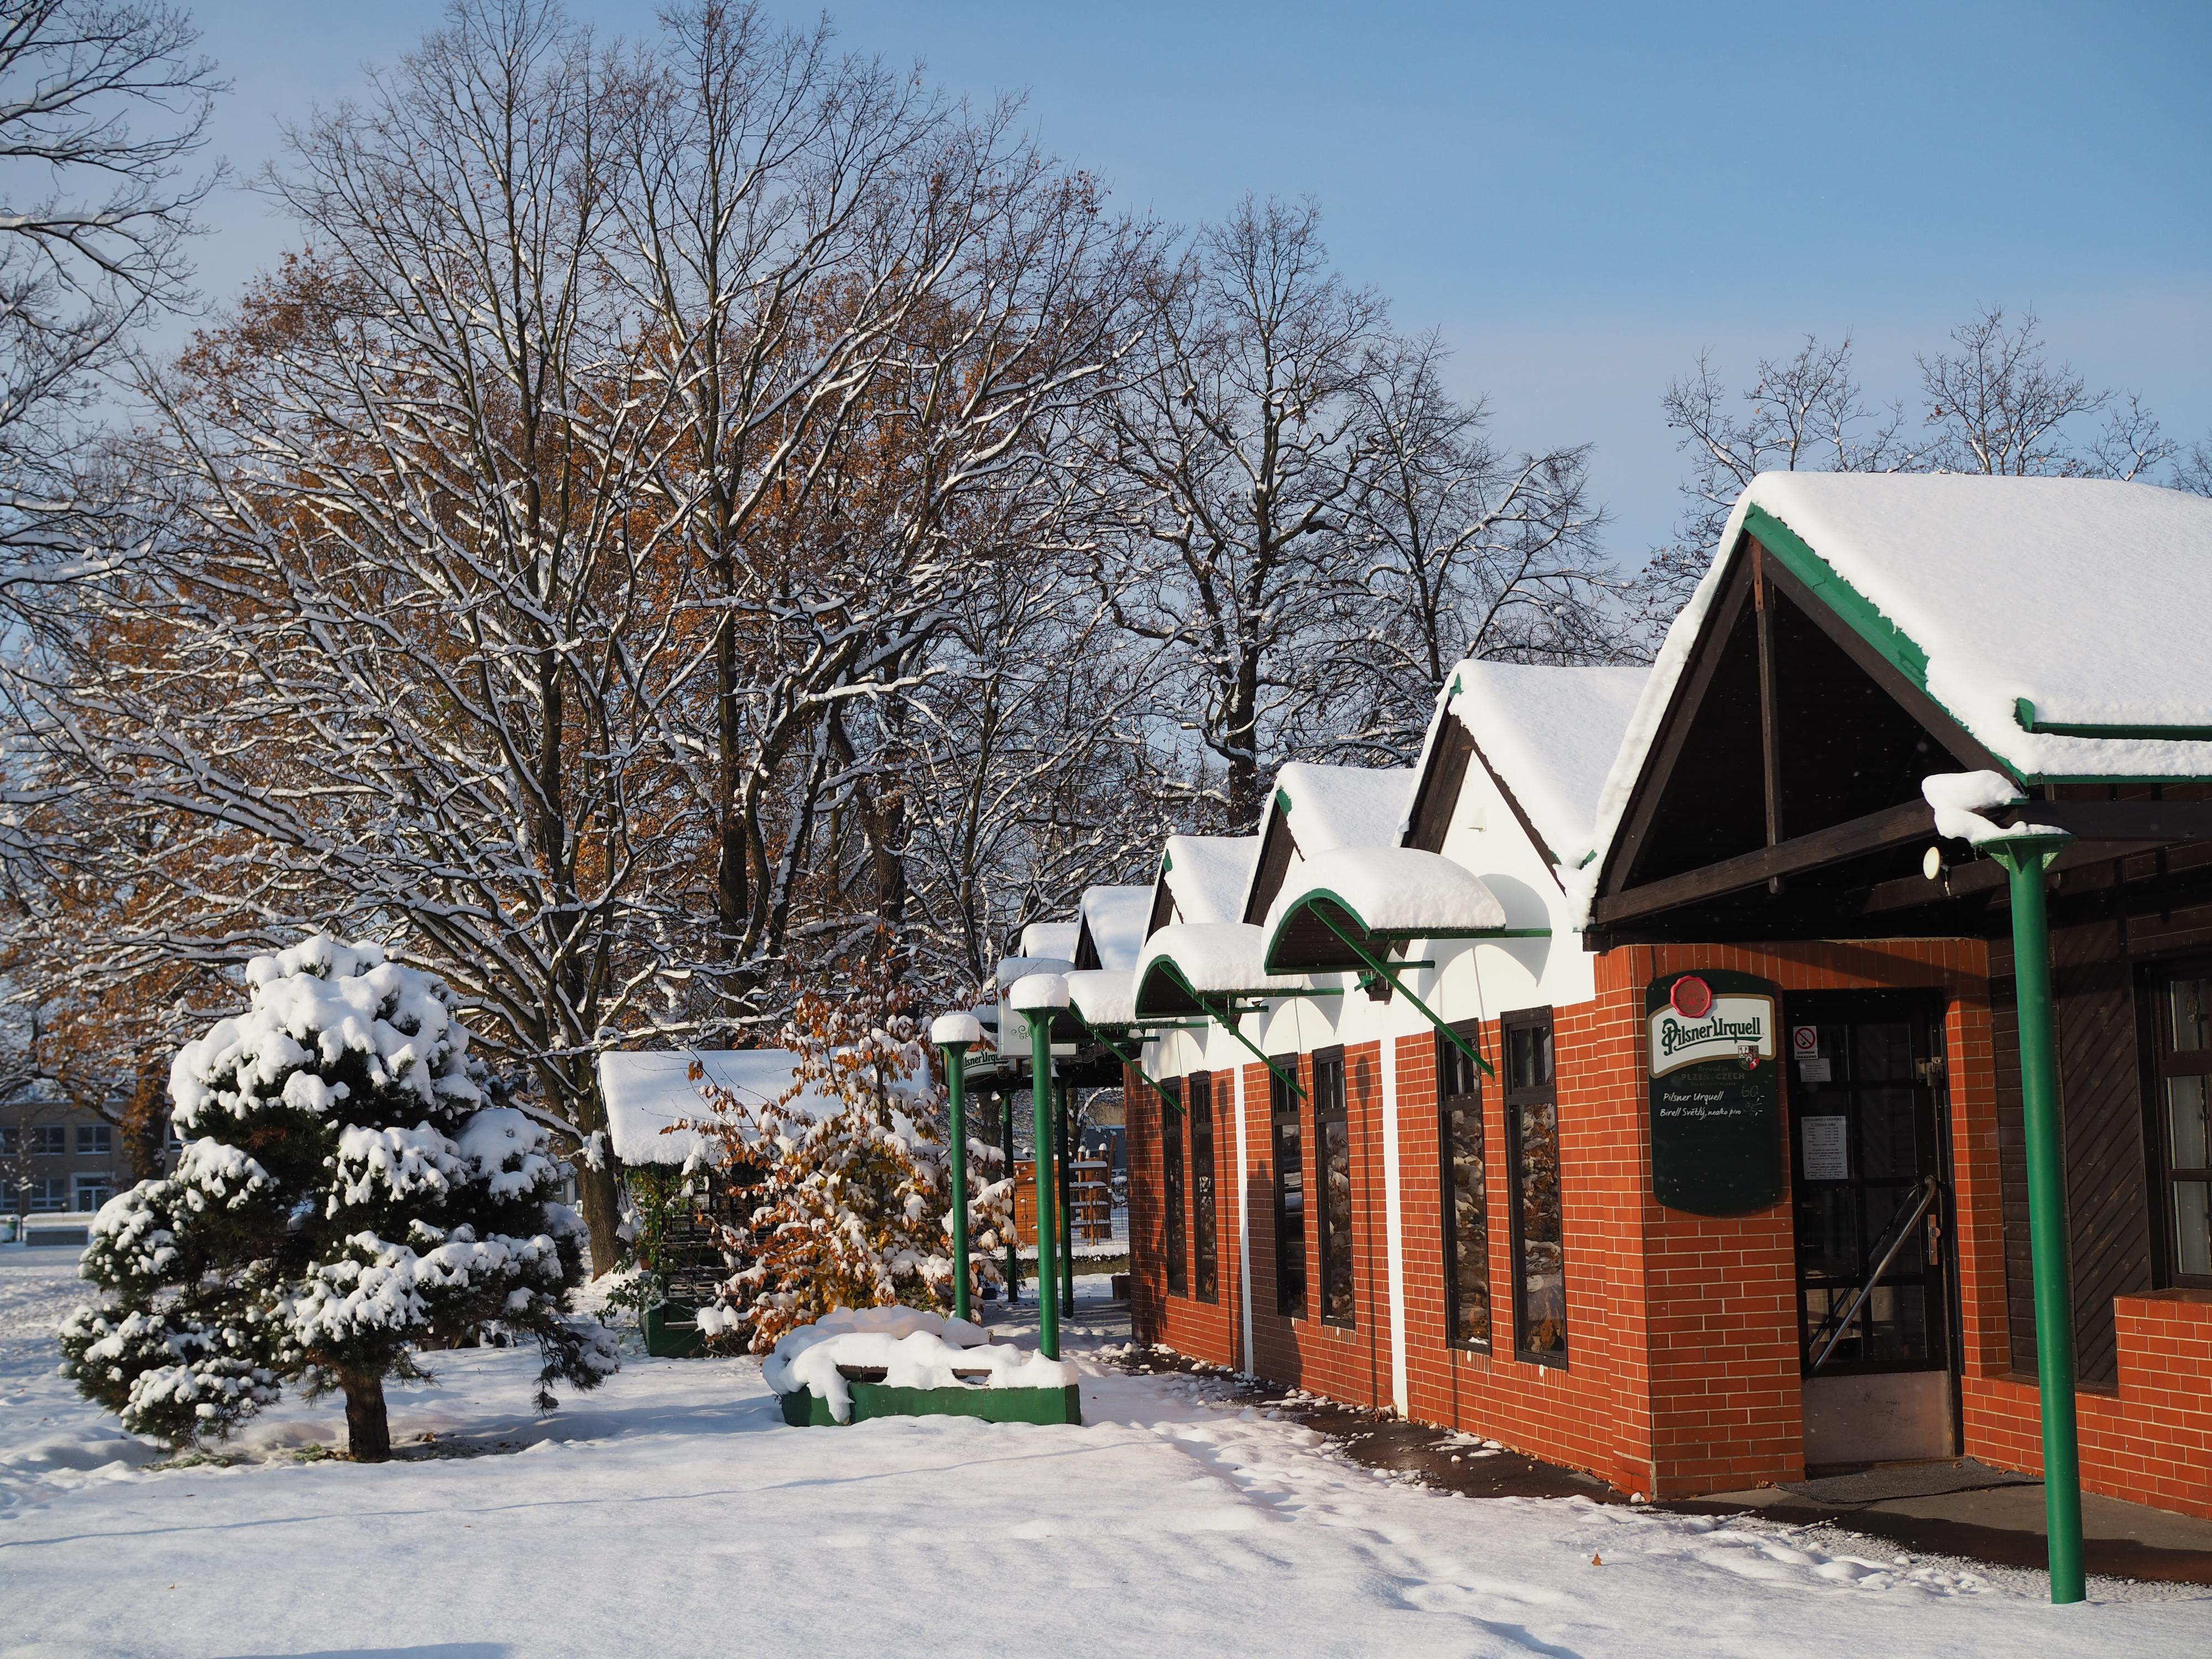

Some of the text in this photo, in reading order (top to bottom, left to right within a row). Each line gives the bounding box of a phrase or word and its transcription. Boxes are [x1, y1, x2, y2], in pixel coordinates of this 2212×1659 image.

[1661, 1016, 1761, 1056] Pilsner Urquell
[963, 1055, 982, 1067] ilsner
[1663, 1092, 1692, 1102] Pilsner
[1693, 1091, 1724, 1105] Urquell
[1660, 1107, 1681, 1117] Birell
